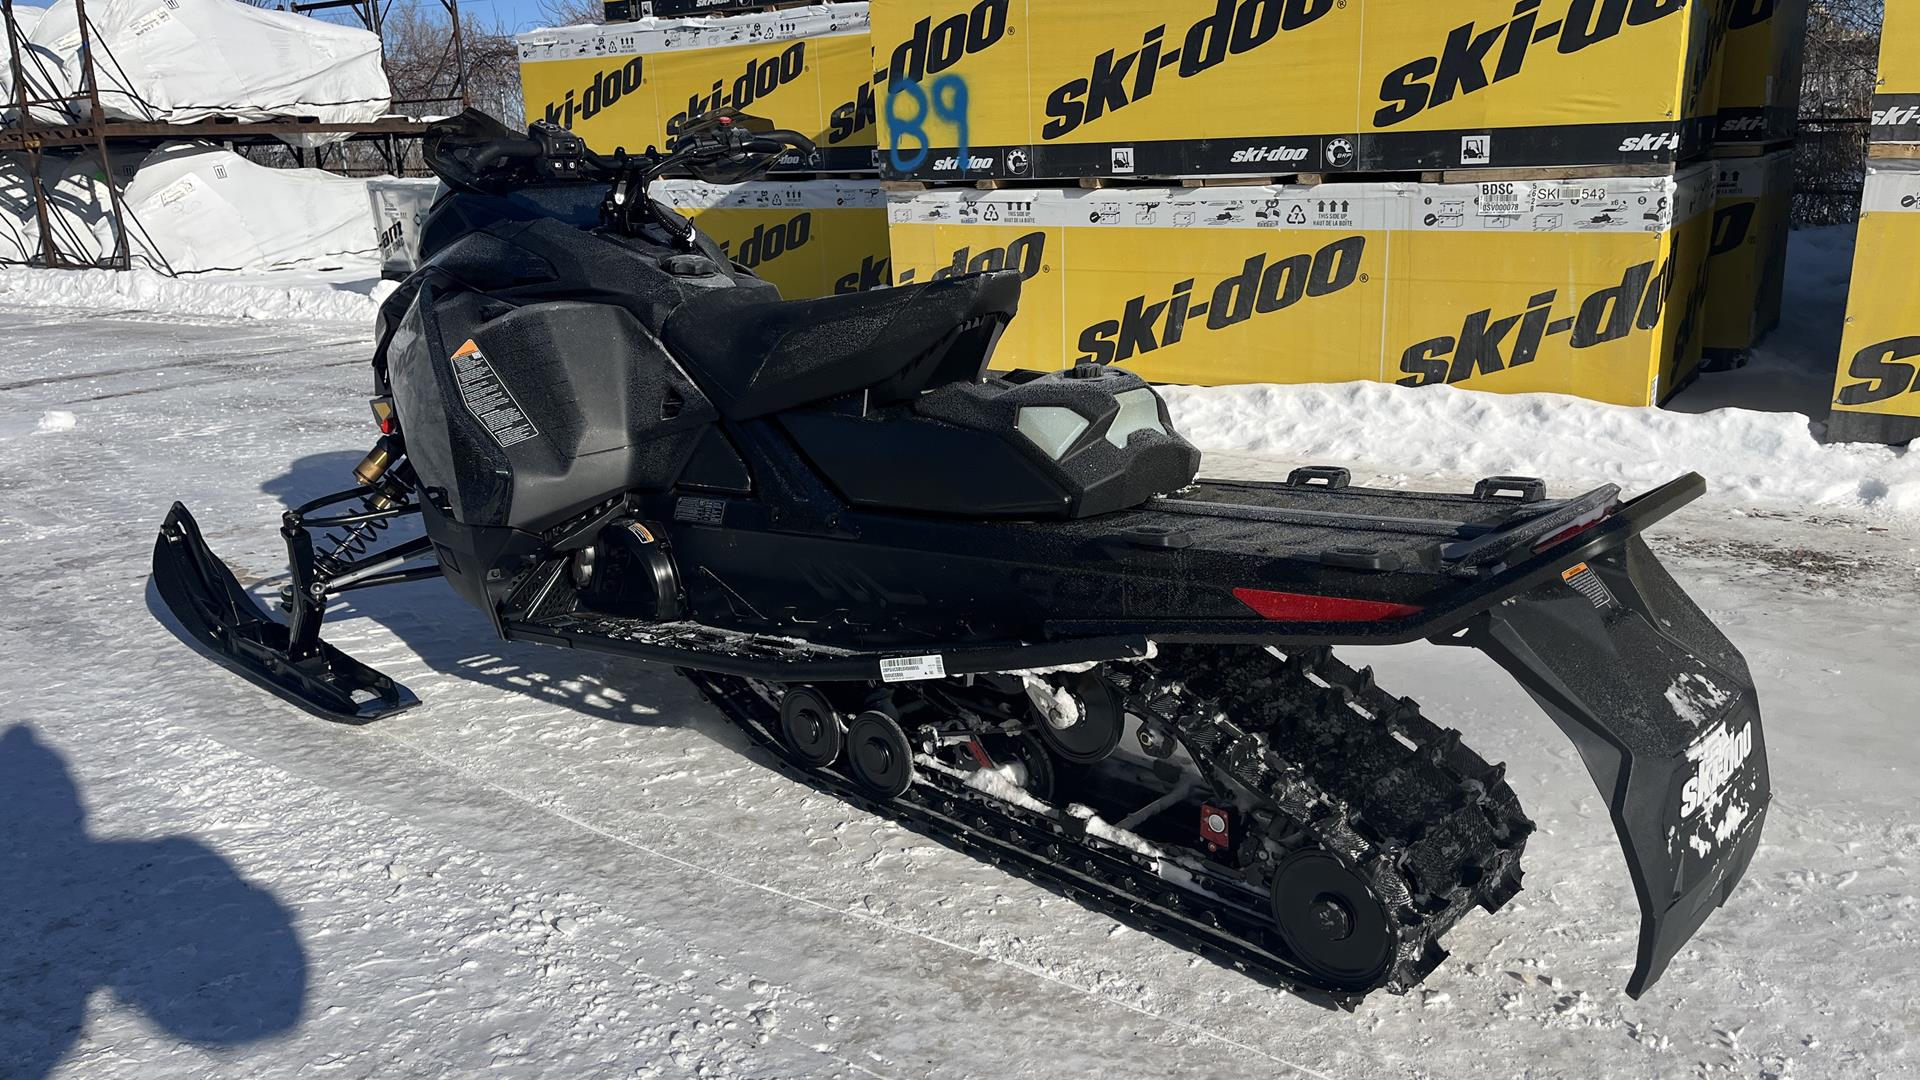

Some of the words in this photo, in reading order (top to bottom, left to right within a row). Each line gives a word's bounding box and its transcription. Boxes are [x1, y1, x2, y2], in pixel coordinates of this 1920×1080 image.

[1042, 0, 1334, 140] ski-doo
[545, 56, 643, 131] ki-doo
[886, 74, 970, 172] 89
[932, 155, 994, 171] skidoo
[1230, 145, 1309, 163] ski-doo
[1482, 183, 1513, 195] BDSC
[1537, 188, 1560, 200] SKI
[1581, 188, 1606, 200] 543
[1318, 212, 1329, 220] THIS
[1329, 212, 1340, 220] SIDE
[1340, 212, 1348, 220] UP
[1074, 235, 1367, 369] ski-doo
